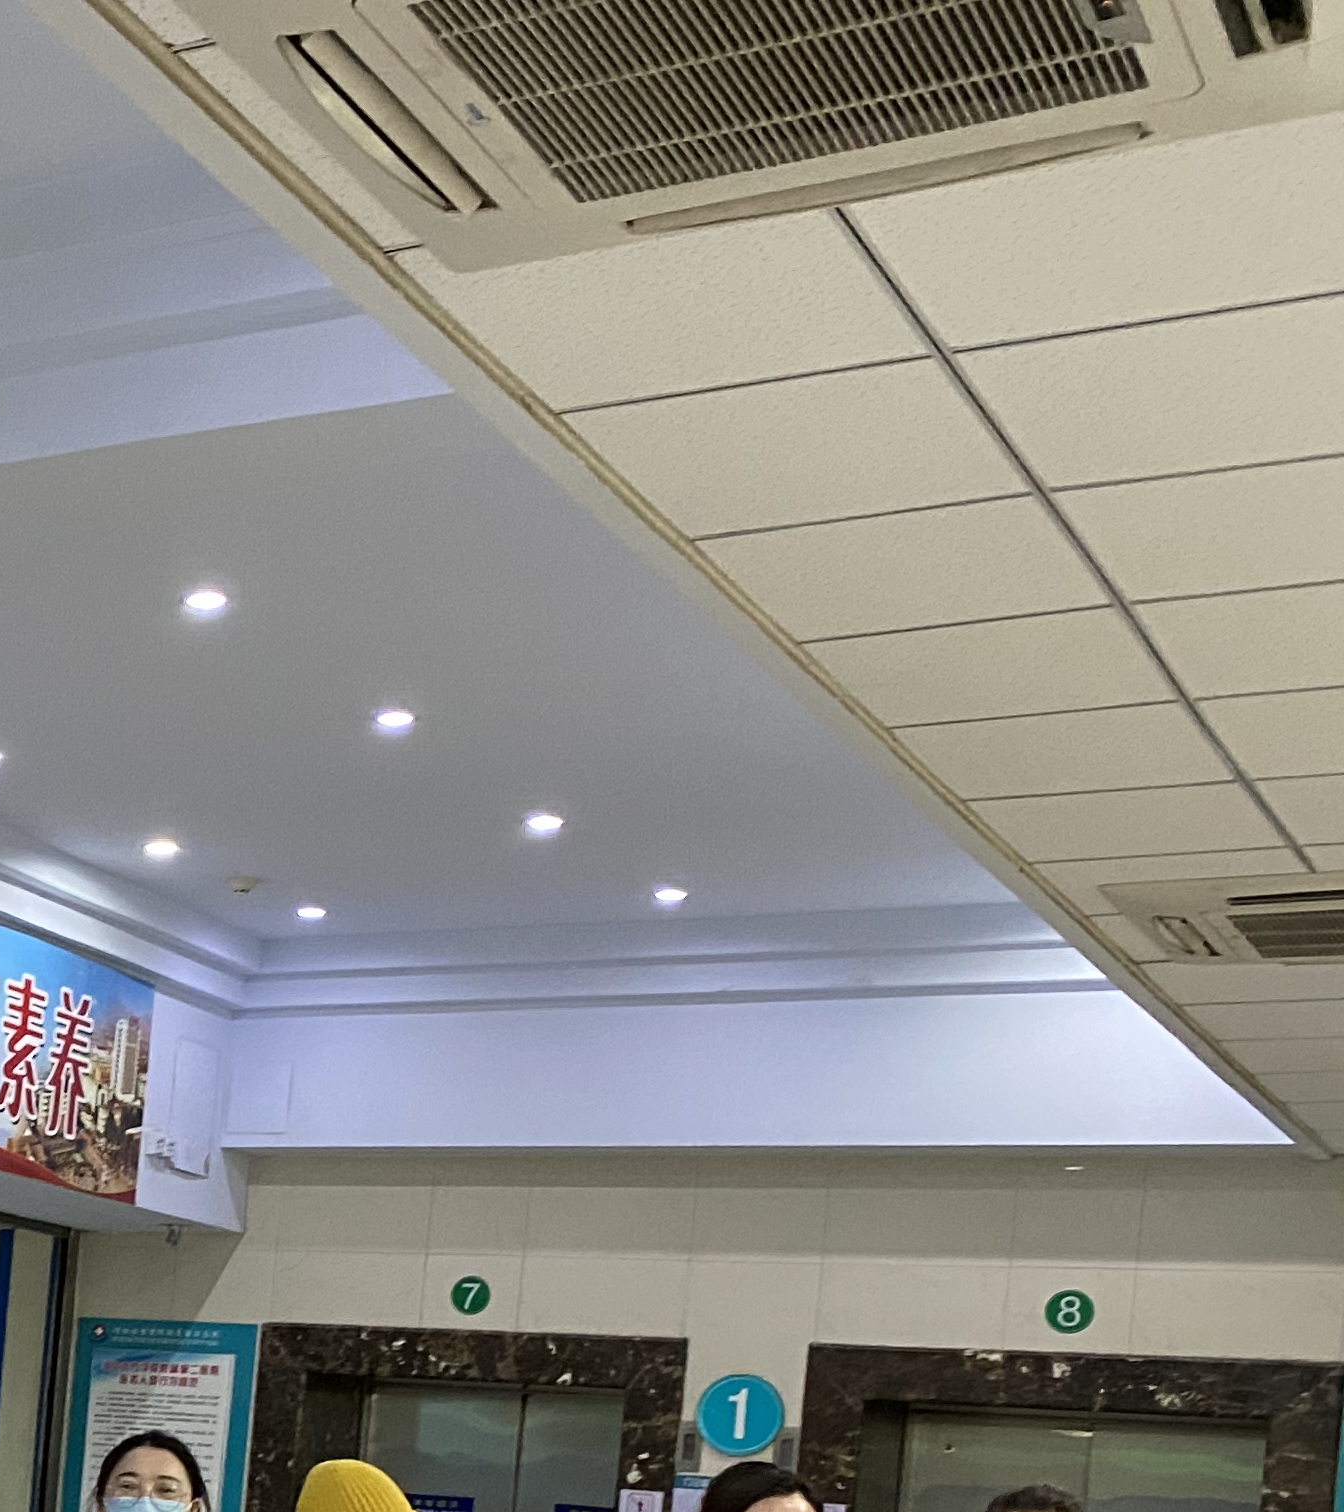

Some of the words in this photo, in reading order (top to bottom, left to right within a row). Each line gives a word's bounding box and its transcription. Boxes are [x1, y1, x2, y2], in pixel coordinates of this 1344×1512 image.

[461, 1282, 481, 1310] 7
[1057, 1295, 1081, 1327] 8
[727, 1386, 750, 1440] 1
